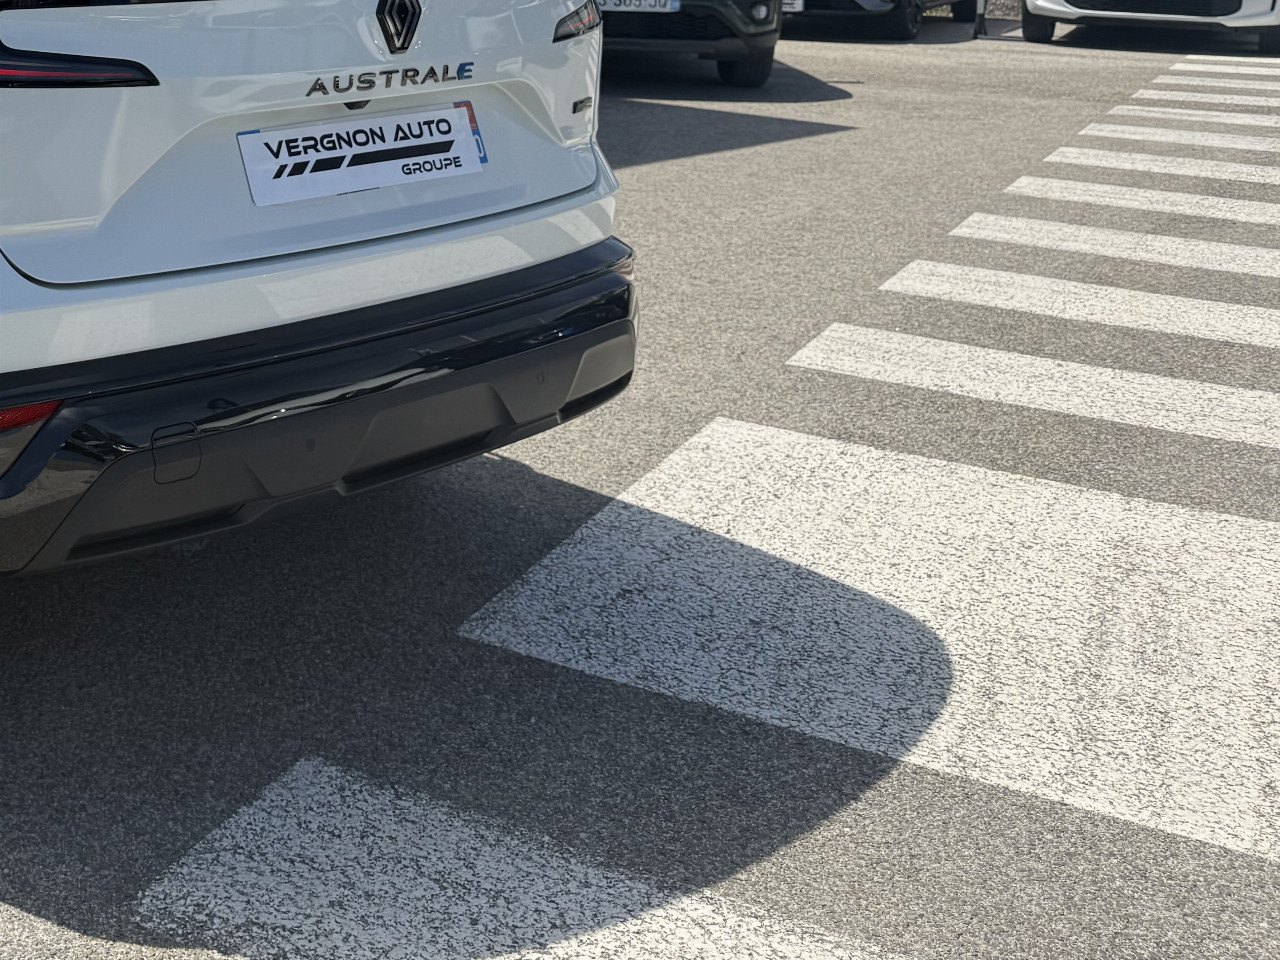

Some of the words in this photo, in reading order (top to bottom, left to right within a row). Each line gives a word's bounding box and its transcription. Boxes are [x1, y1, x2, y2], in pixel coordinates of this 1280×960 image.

[263, 125, 386, 160] VERGNON
[393, 118, 452, 143] AUTO
[401, 156, 463, 176] GROUPE
